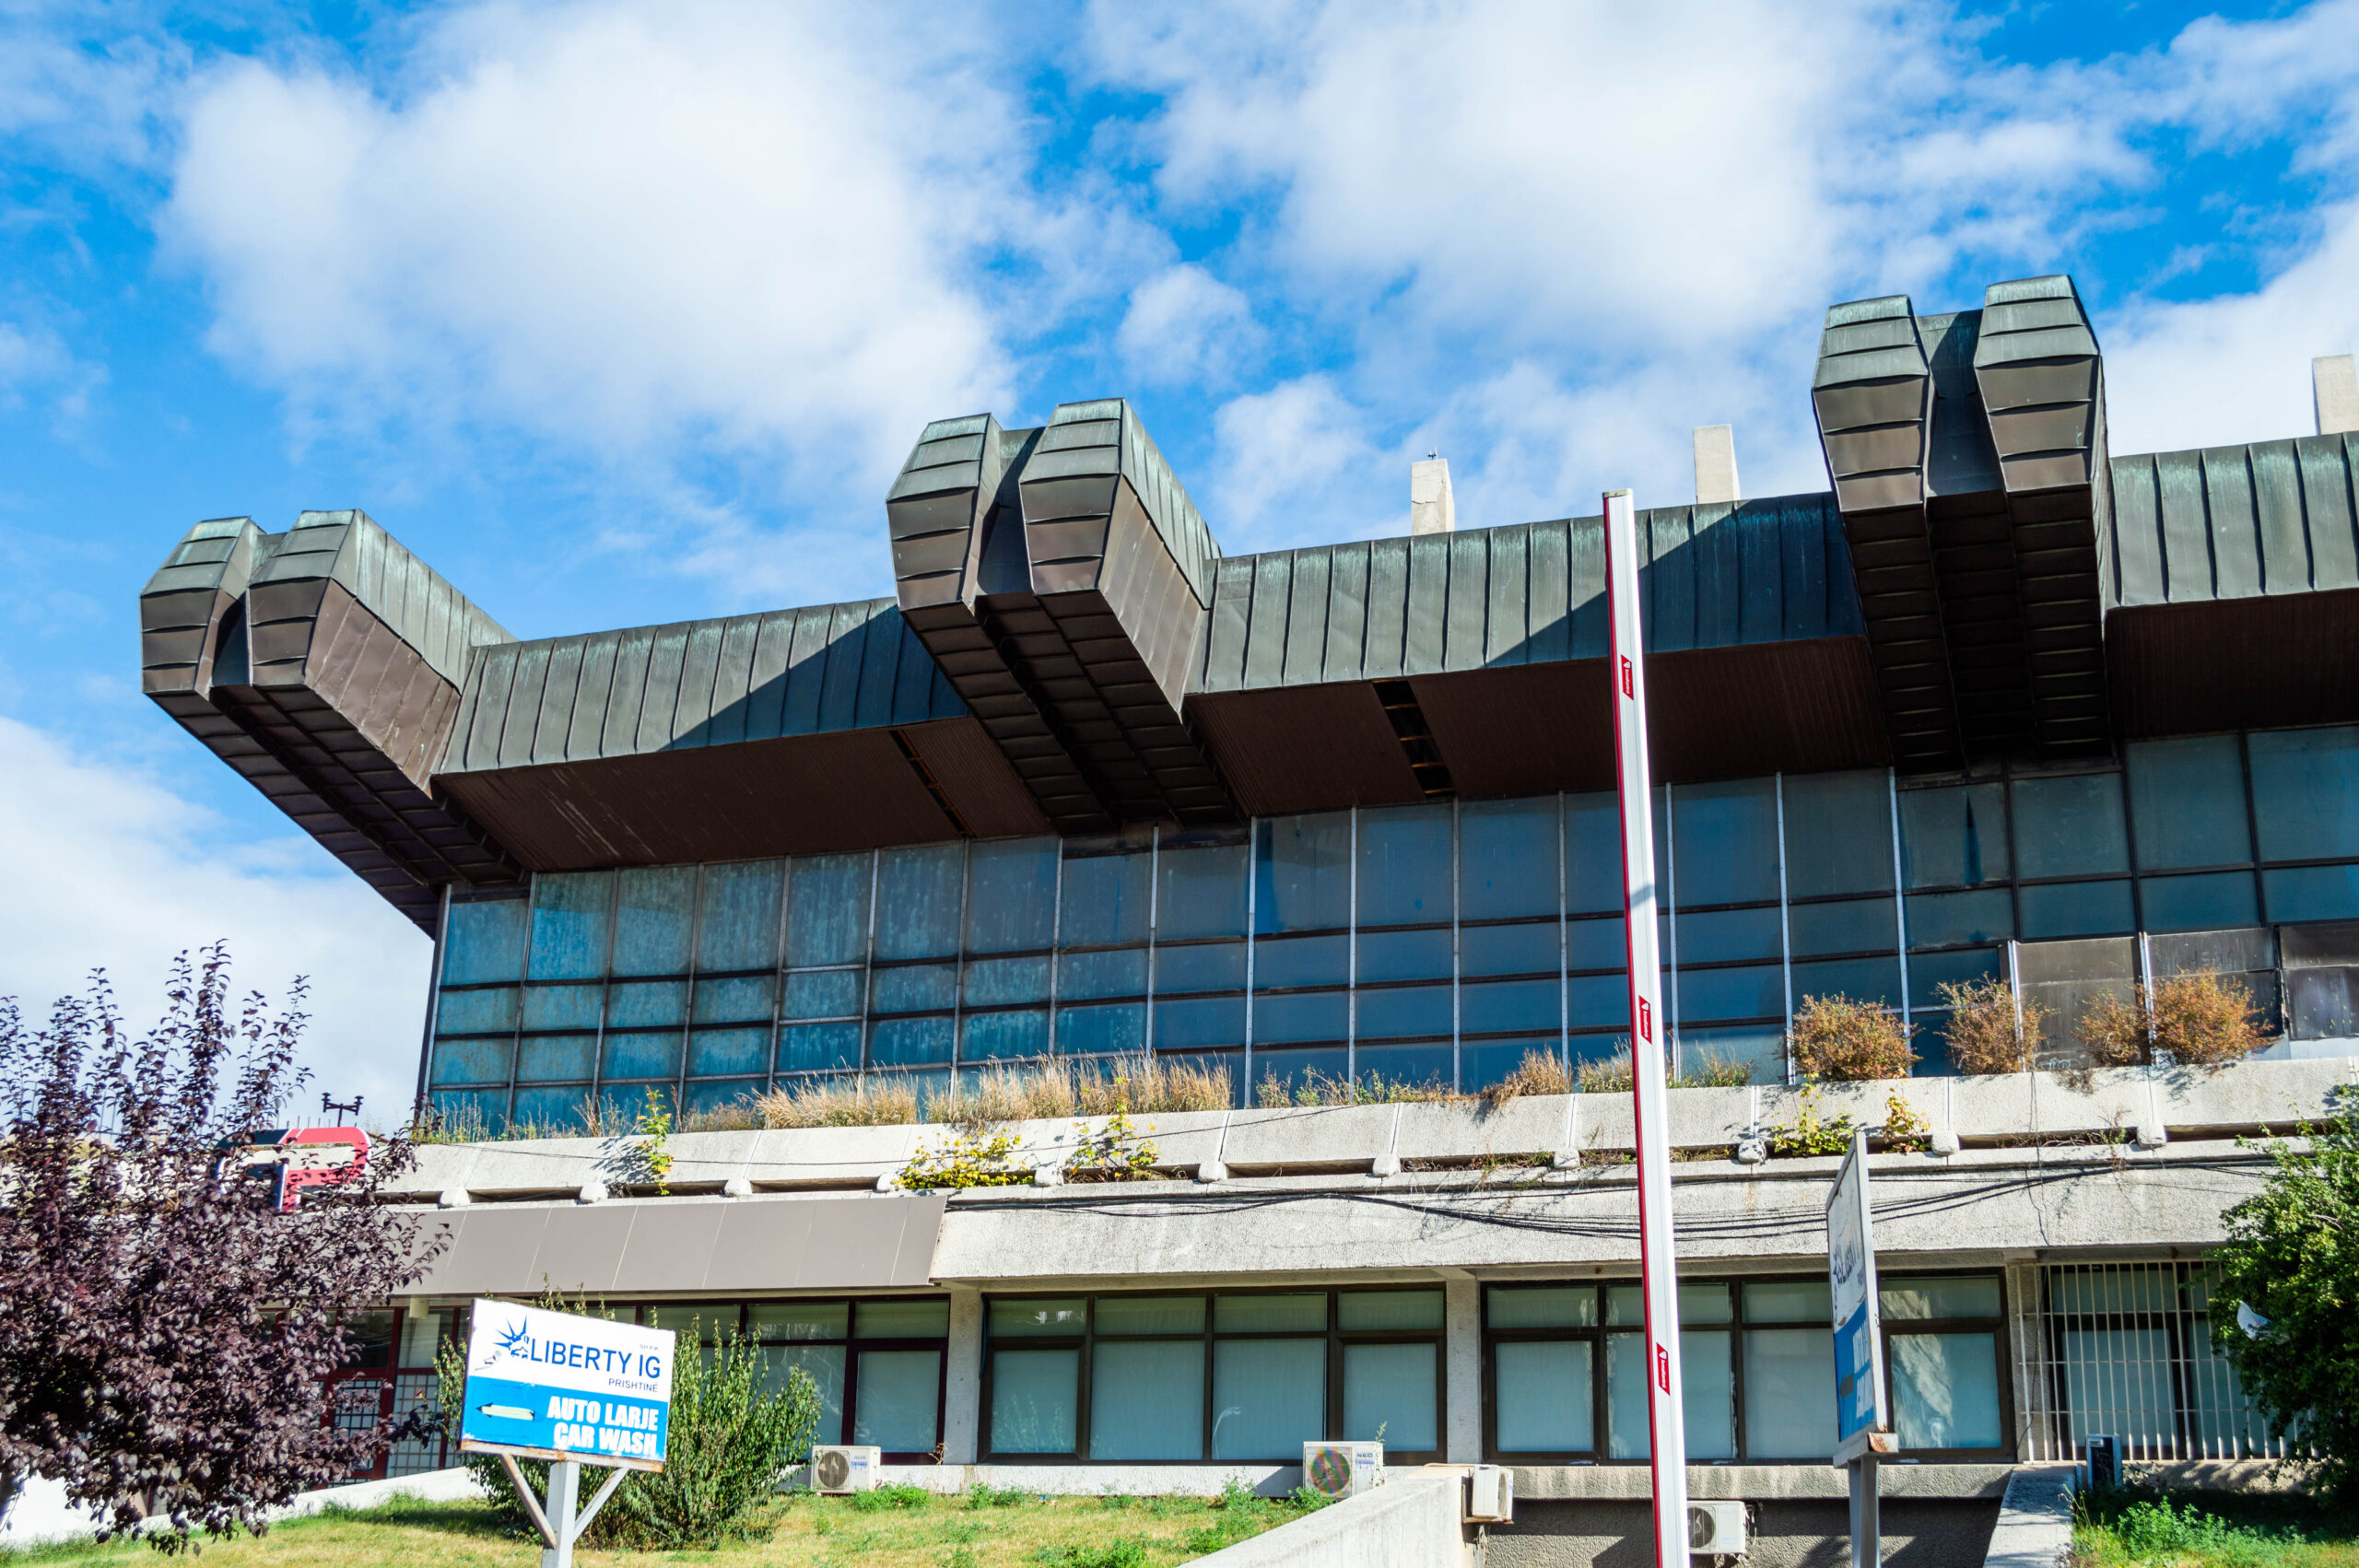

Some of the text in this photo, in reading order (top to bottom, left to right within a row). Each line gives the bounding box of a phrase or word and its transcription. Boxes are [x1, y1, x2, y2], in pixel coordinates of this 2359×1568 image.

[531, 1338, 661, 1379] LIBERTY IG
[547, 1397, 659, 1431] AUTO LARJE
[554, 1422, 658, 1455] CAR WASH
